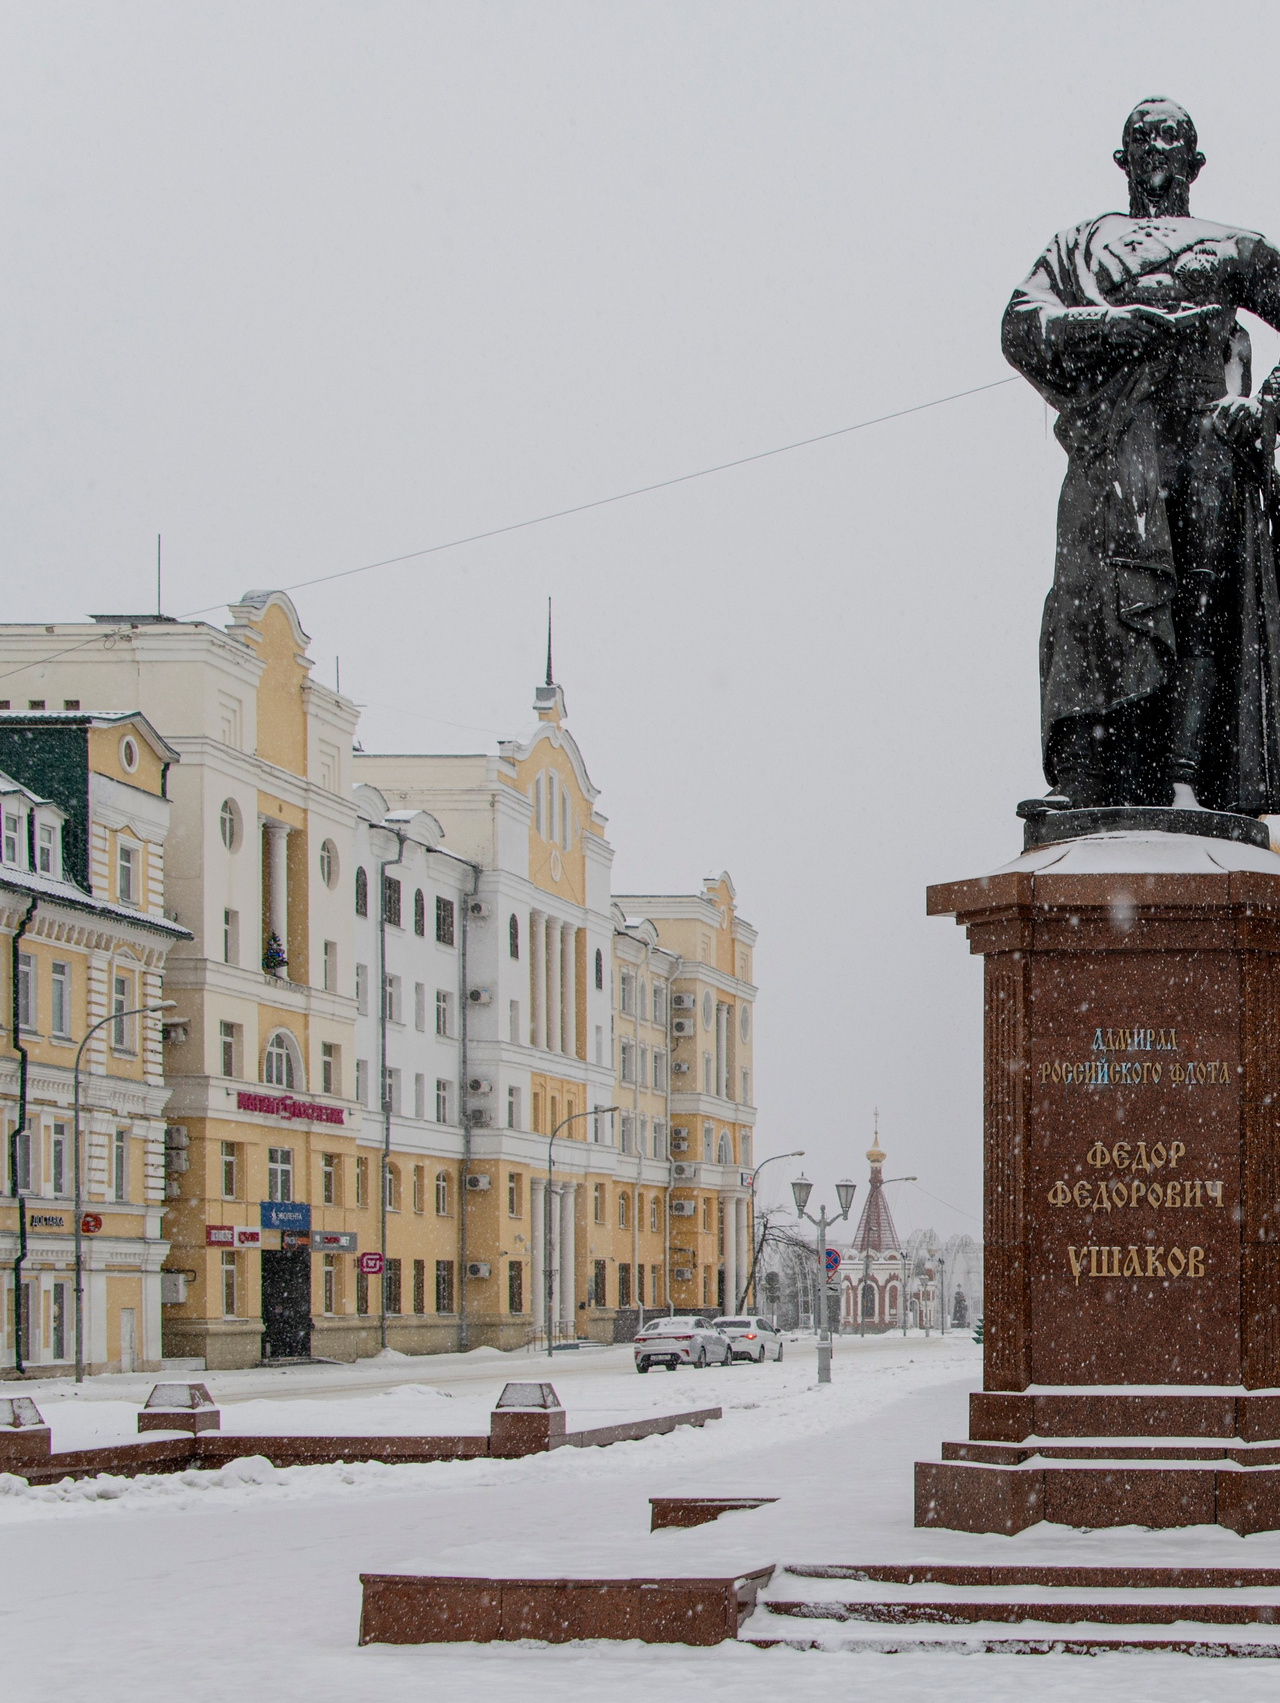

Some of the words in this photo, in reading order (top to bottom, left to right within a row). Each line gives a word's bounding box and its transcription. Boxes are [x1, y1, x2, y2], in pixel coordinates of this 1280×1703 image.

[1092, 1028, 1178, 1050] АДМИРАЛ
[1041, 1058, 1162, 1084] РОССИЙСКОГО
[1170, 1062, 1231, 1084] ФЛОТА
[1086, 1141, 1186, 1174] ФЕДОР
[1047, 1180, 1224, 1215] ФЕДОРОВИЧ
[1067, 1246, 1205, 1286] УШАКОВ
